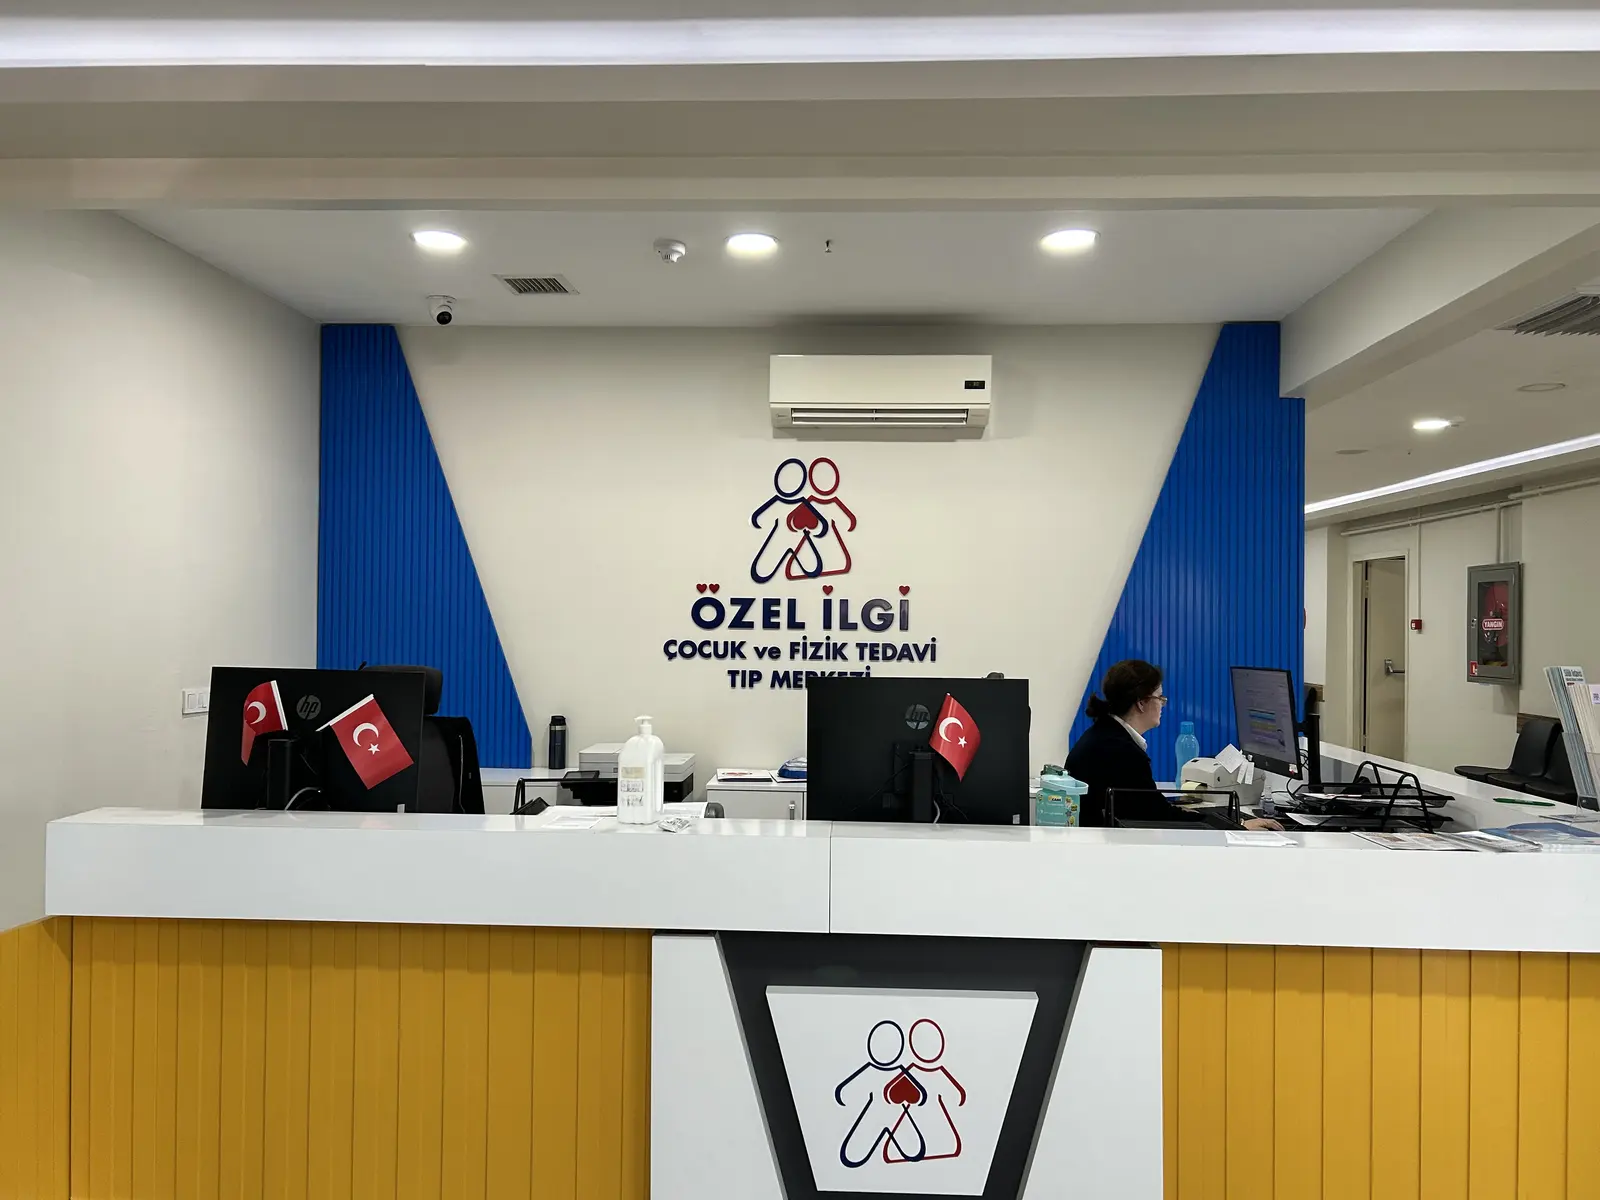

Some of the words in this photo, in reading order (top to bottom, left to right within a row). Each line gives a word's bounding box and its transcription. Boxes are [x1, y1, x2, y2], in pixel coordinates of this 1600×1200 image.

[691, 583, 806, 630] ÖZEL
[822, 584, 911, 632] İLGİ
[663, 639, 747, 661] ÇOCUK
[753, 646, 782, 661] ve
[789, 635, 849, 662] FİZİK
[855, 637, 937, 662] TEDAVİ
[727, 669, 763, 689] TIP
[298, 695, 320, 719] hp
[906, 704, 929, 729] hp
